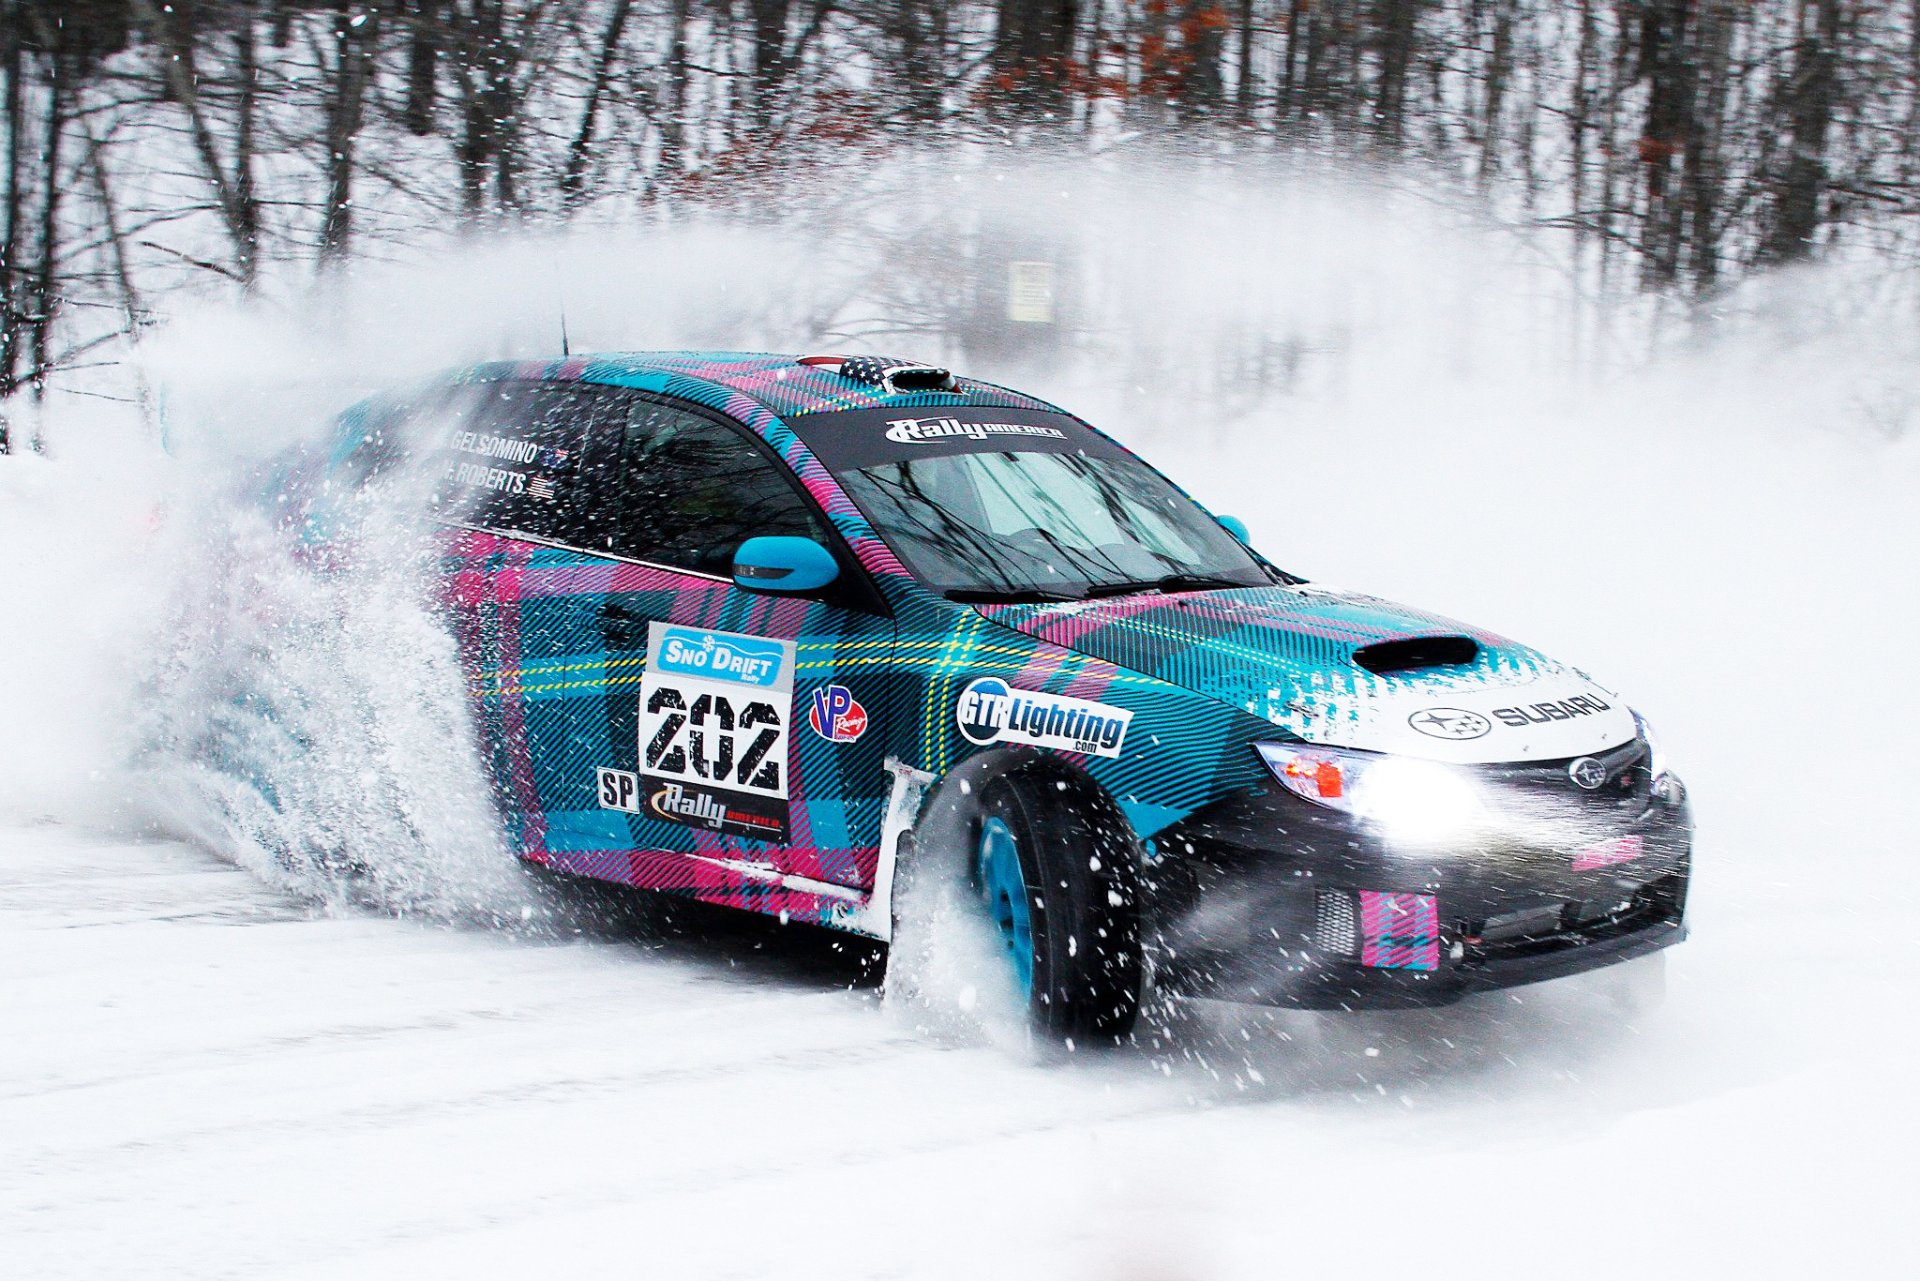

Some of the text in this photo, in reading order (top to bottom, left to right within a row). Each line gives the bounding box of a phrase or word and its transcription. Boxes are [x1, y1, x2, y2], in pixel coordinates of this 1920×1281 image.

[450, 430, 539, 463] GELSOMINO
[886, 417, 988, 441] Rally
[456, 462, 526, 494] ROBERTS
[812, 685, 852, 740] VP
[1008, 698, 1124, 749] Lighting
[1492, 693, 1612, 727] SUBARU
[646, 687, 781, 791] 202
[1072, 740, 1098, 754] .com
[602, 772, 635, 808] SP
[663, 782, 727, 829] Rally
